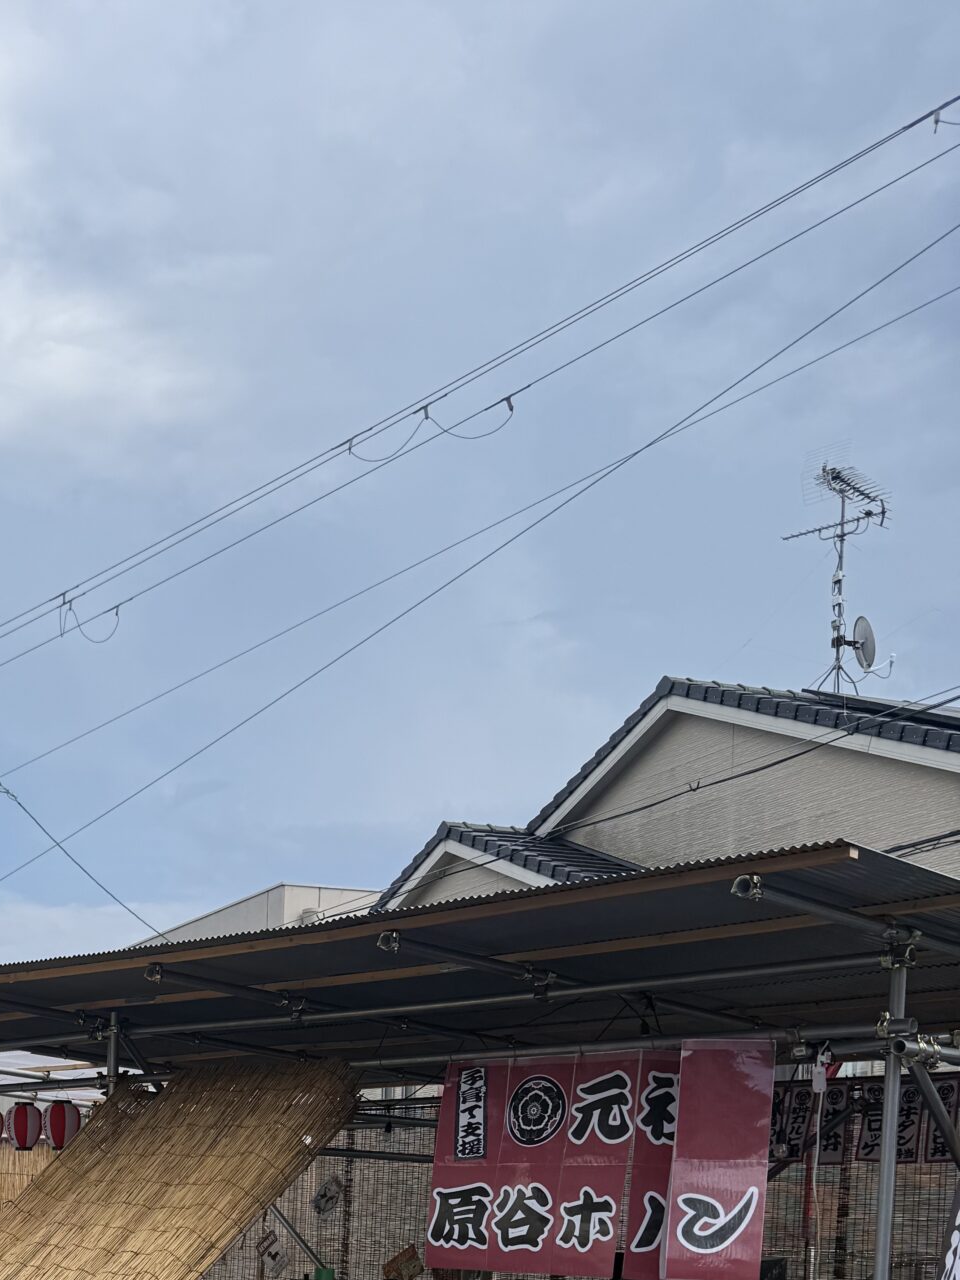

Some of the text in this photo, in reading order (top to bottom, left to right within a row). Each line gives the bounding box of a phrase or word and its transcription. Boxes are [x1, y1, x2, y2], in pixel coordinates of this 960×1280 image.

[457, 1067, 483, 1157] 子育て支援
